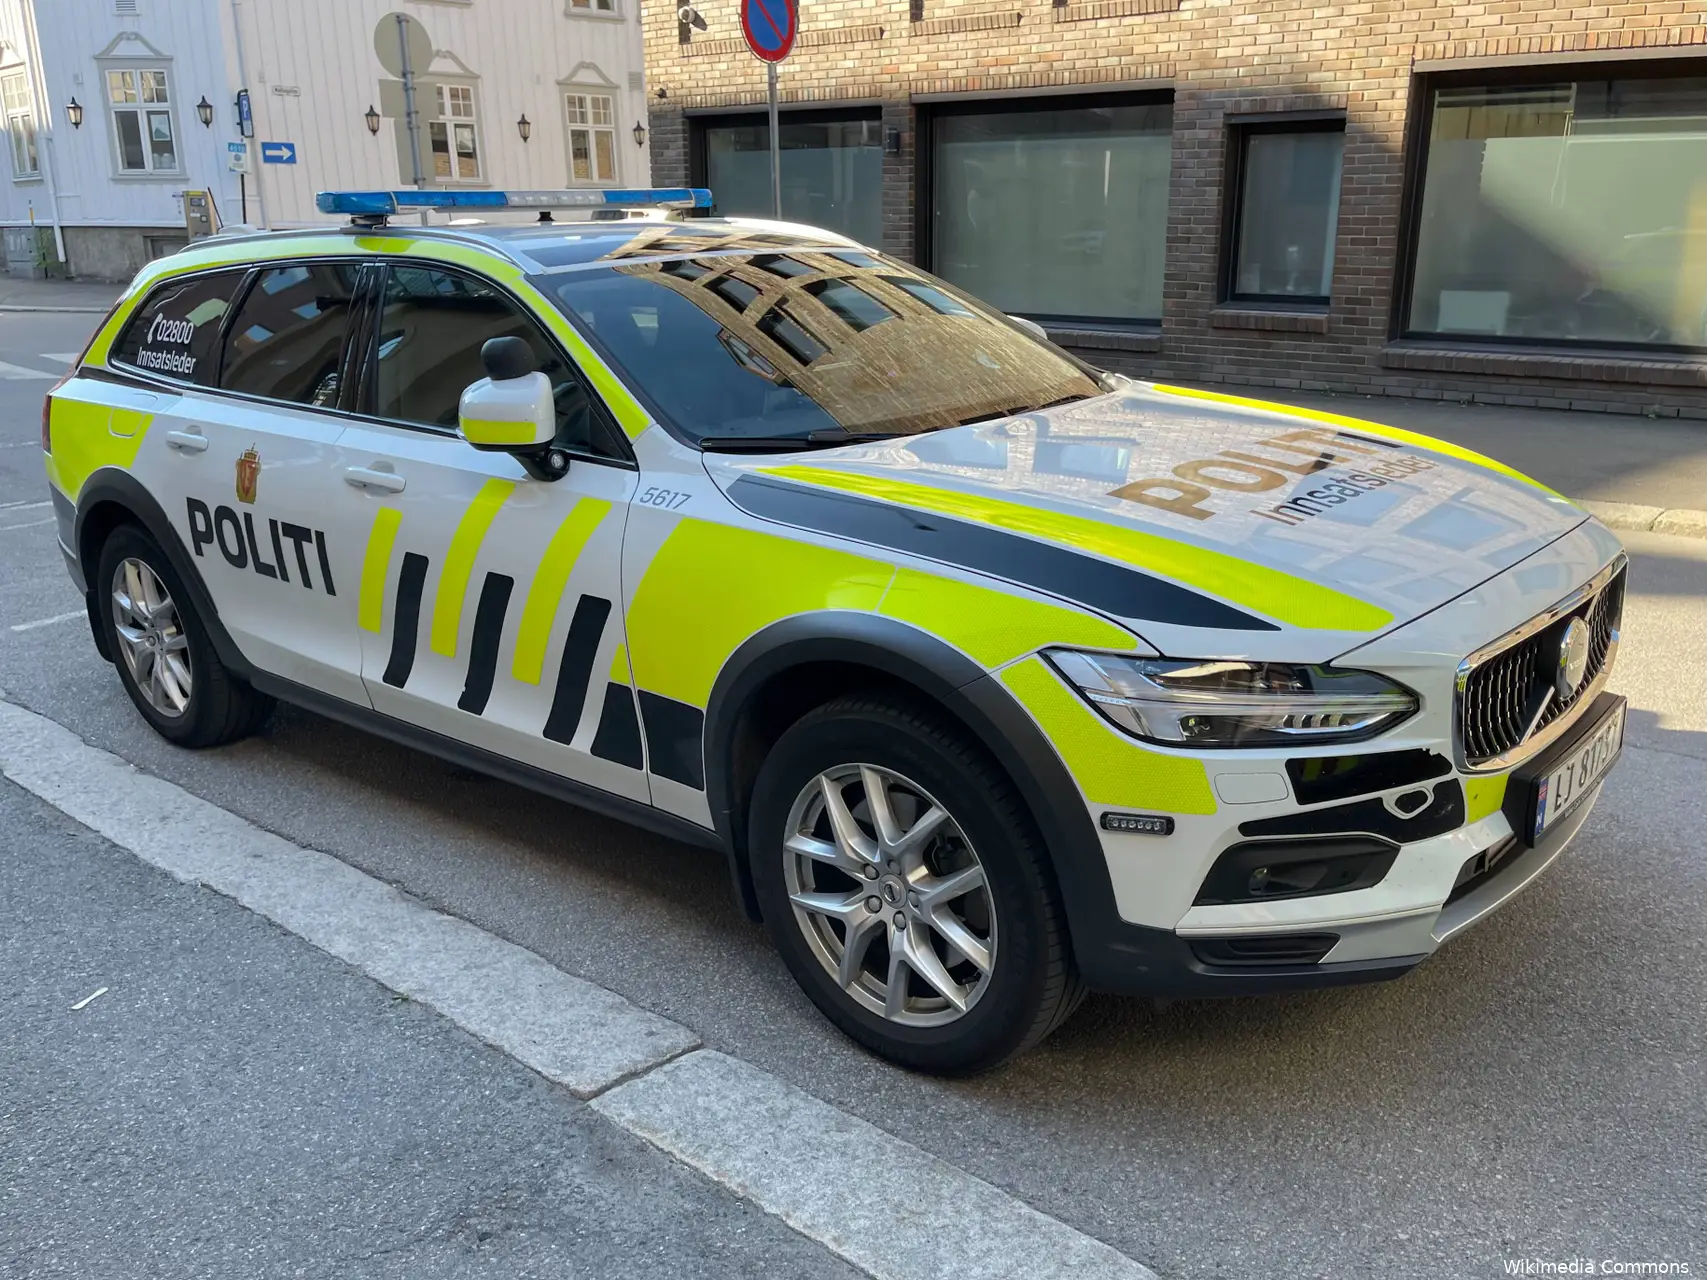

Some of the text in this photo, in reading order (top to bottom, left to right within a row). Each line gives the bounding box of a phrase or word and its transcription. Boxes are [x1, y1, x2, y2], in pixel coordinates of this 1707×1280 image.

[157, 320, 194, 344] 02800
[137, 347, 196, 374] Innsatsleder
[640, 487, 692, 509] 5617
[1106, 428, 1403, 521] POLITI
[1249, 455, 1439, 526] Innsatsleder
[186, 497, 337, 597] POLITI
